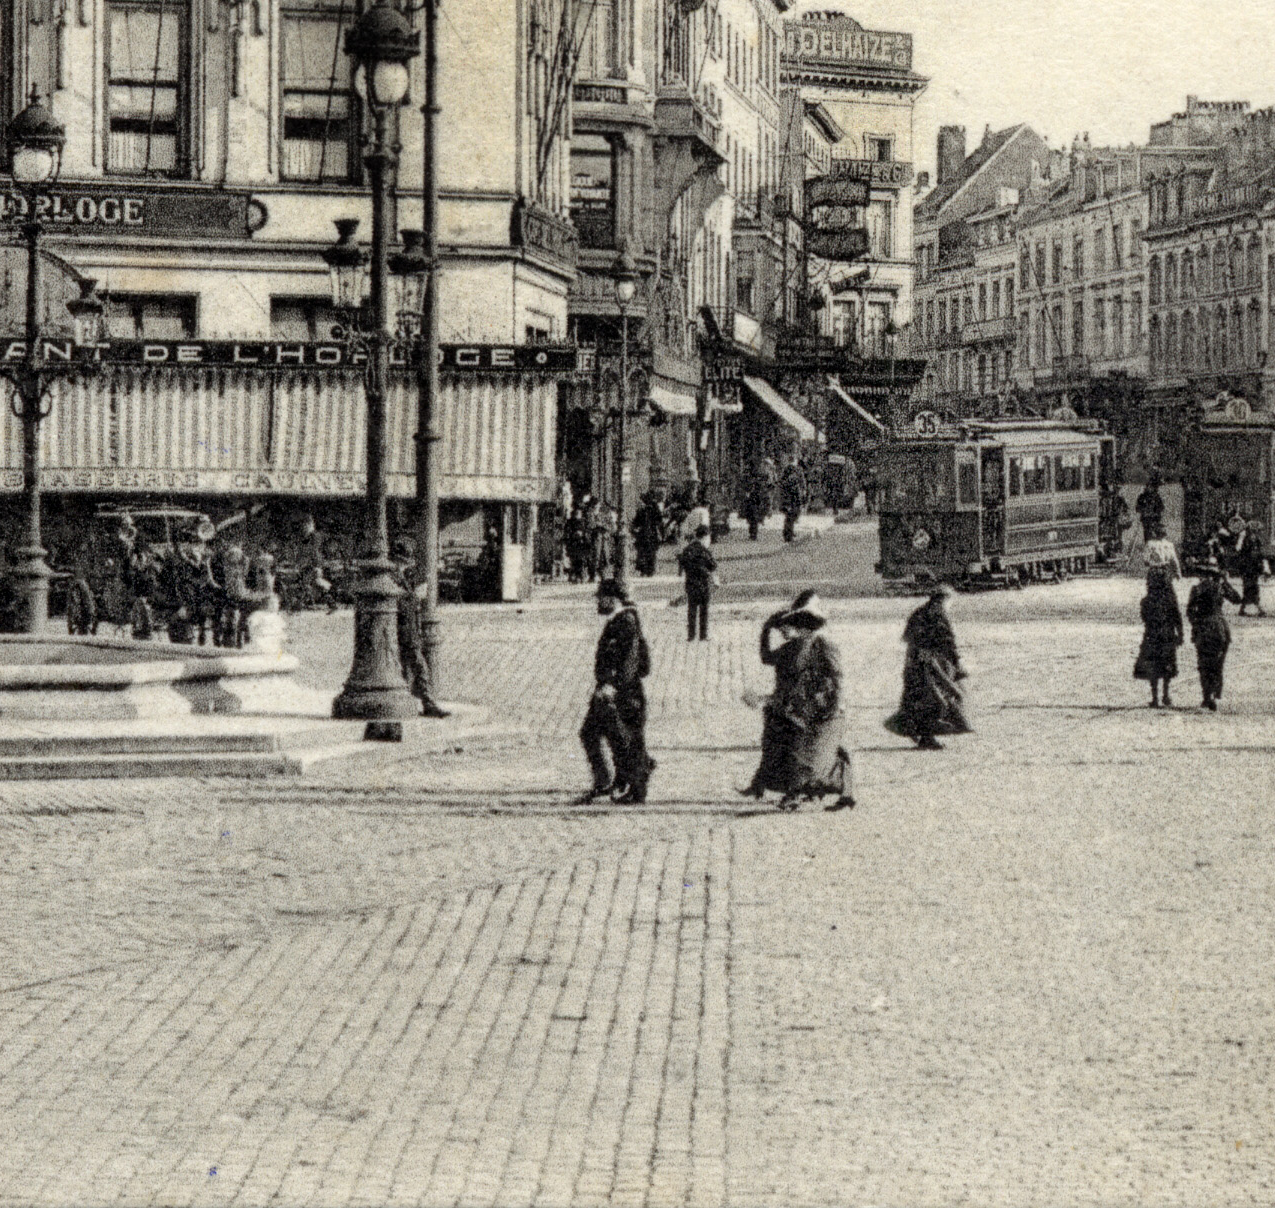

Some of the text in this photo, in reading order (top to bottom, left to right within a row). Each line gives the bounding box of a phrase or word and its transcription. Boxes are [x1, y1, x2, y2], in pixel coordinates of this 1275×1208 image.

[795, 28, 893, 63] DELHAIZE
[143, 344, 203, 363] DE
[233, 345, 516, 368] L'HOLGE
[917, 413, 936, 434] 35
[3, 469, 199, 489] BASSERIE
